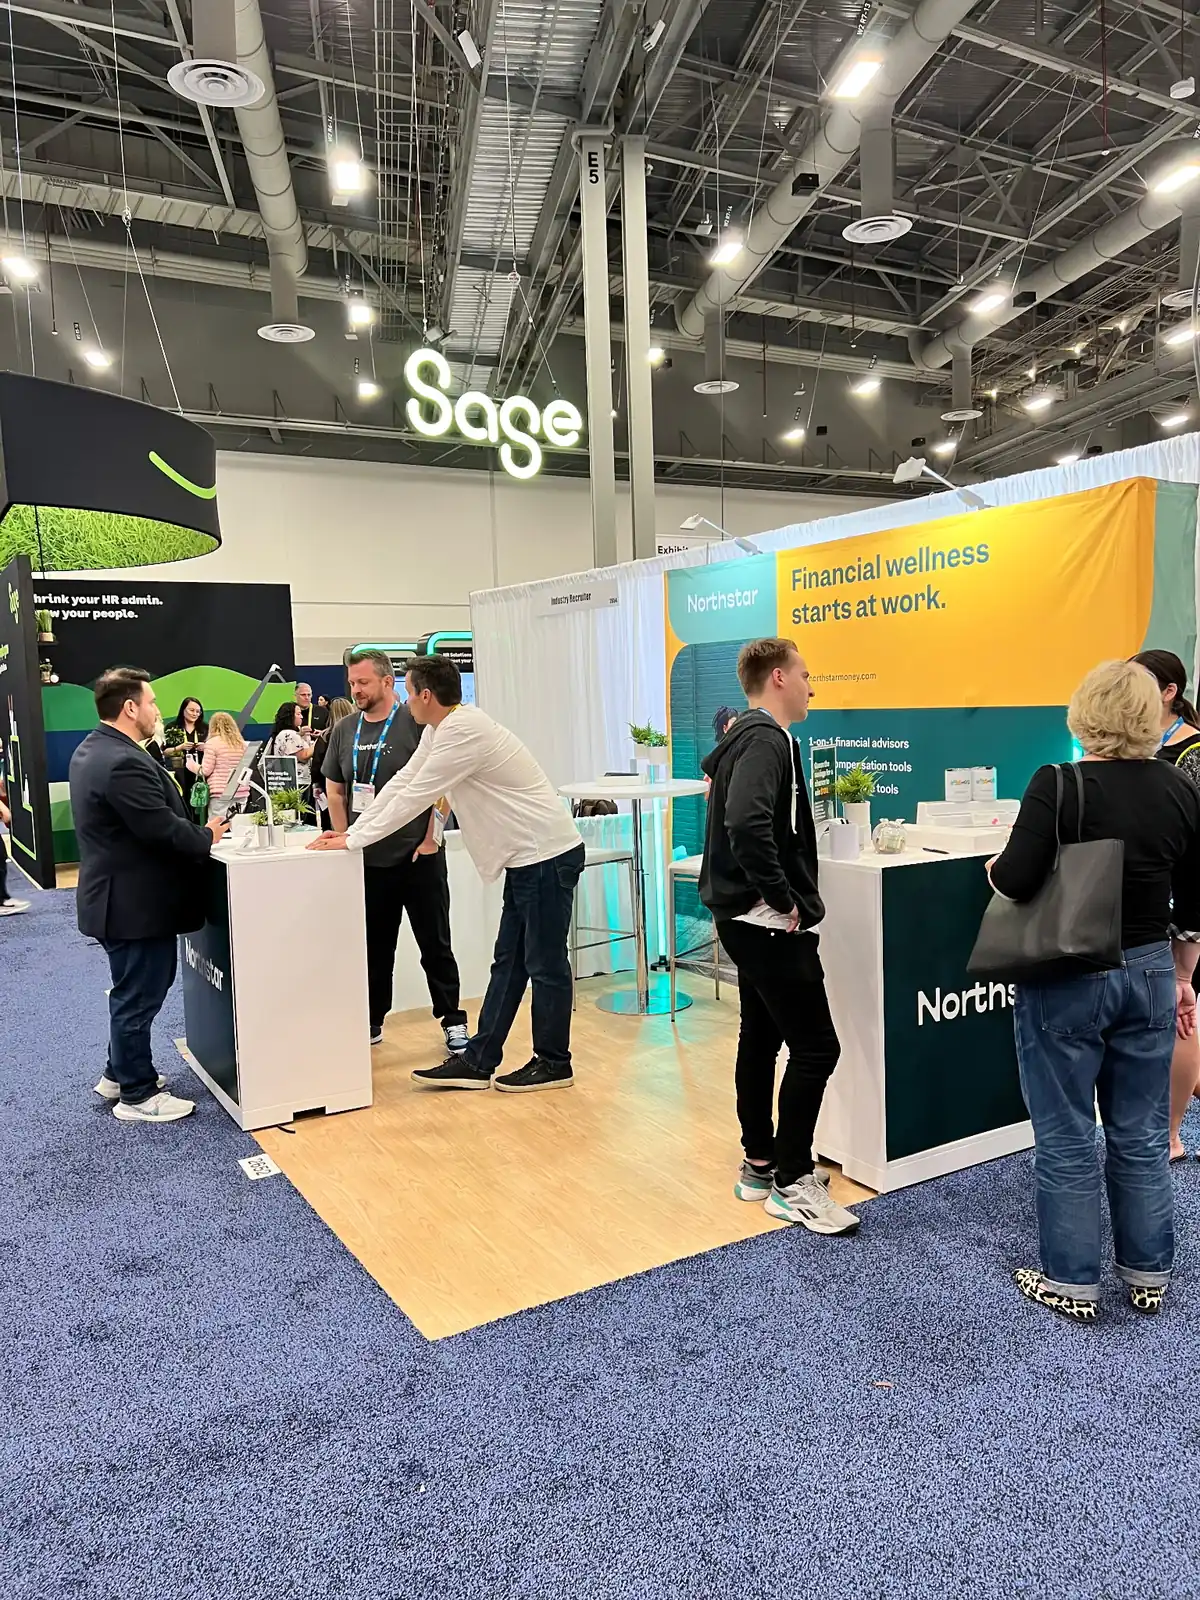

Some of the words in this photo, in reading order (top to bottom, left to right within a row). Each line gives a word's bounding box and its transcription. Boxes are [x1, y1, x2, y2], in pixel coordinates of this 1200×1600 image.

[860, 3, 871, 25] R7-13
[857, 24, 865, 35] W2
[404, 348, 582, 479] Sage
[792, 554, 881, 591] Financial
[885, 543, 989, 577] wellness
[71, 595, 100, 606] your
[101, 594, 120, 605] HR
[121, 594, 163, 605] admin.
[551, 596, 569, 605] Industry
[569, 593, 591, 603] Recruiter
[687, 588, 759, 613] Northstar
[792, 598, 852, 625] starts
[855, 594, 877, 618] at
[881, 584, 946, 615] work.
[61, 609, 91, 620] your
[92, 608, 139, 620] people.
[808, 736, 834, 746] 1-on-1
[835, 736, 870, 748] financial
[871, 737, 910, 749] advisors
[889, 761, 912, 772] tools
[876, 784, 899, 794] tools
[184, 937, 224, 992] Northstar
[917, 981, 1015, 1026] Norths
